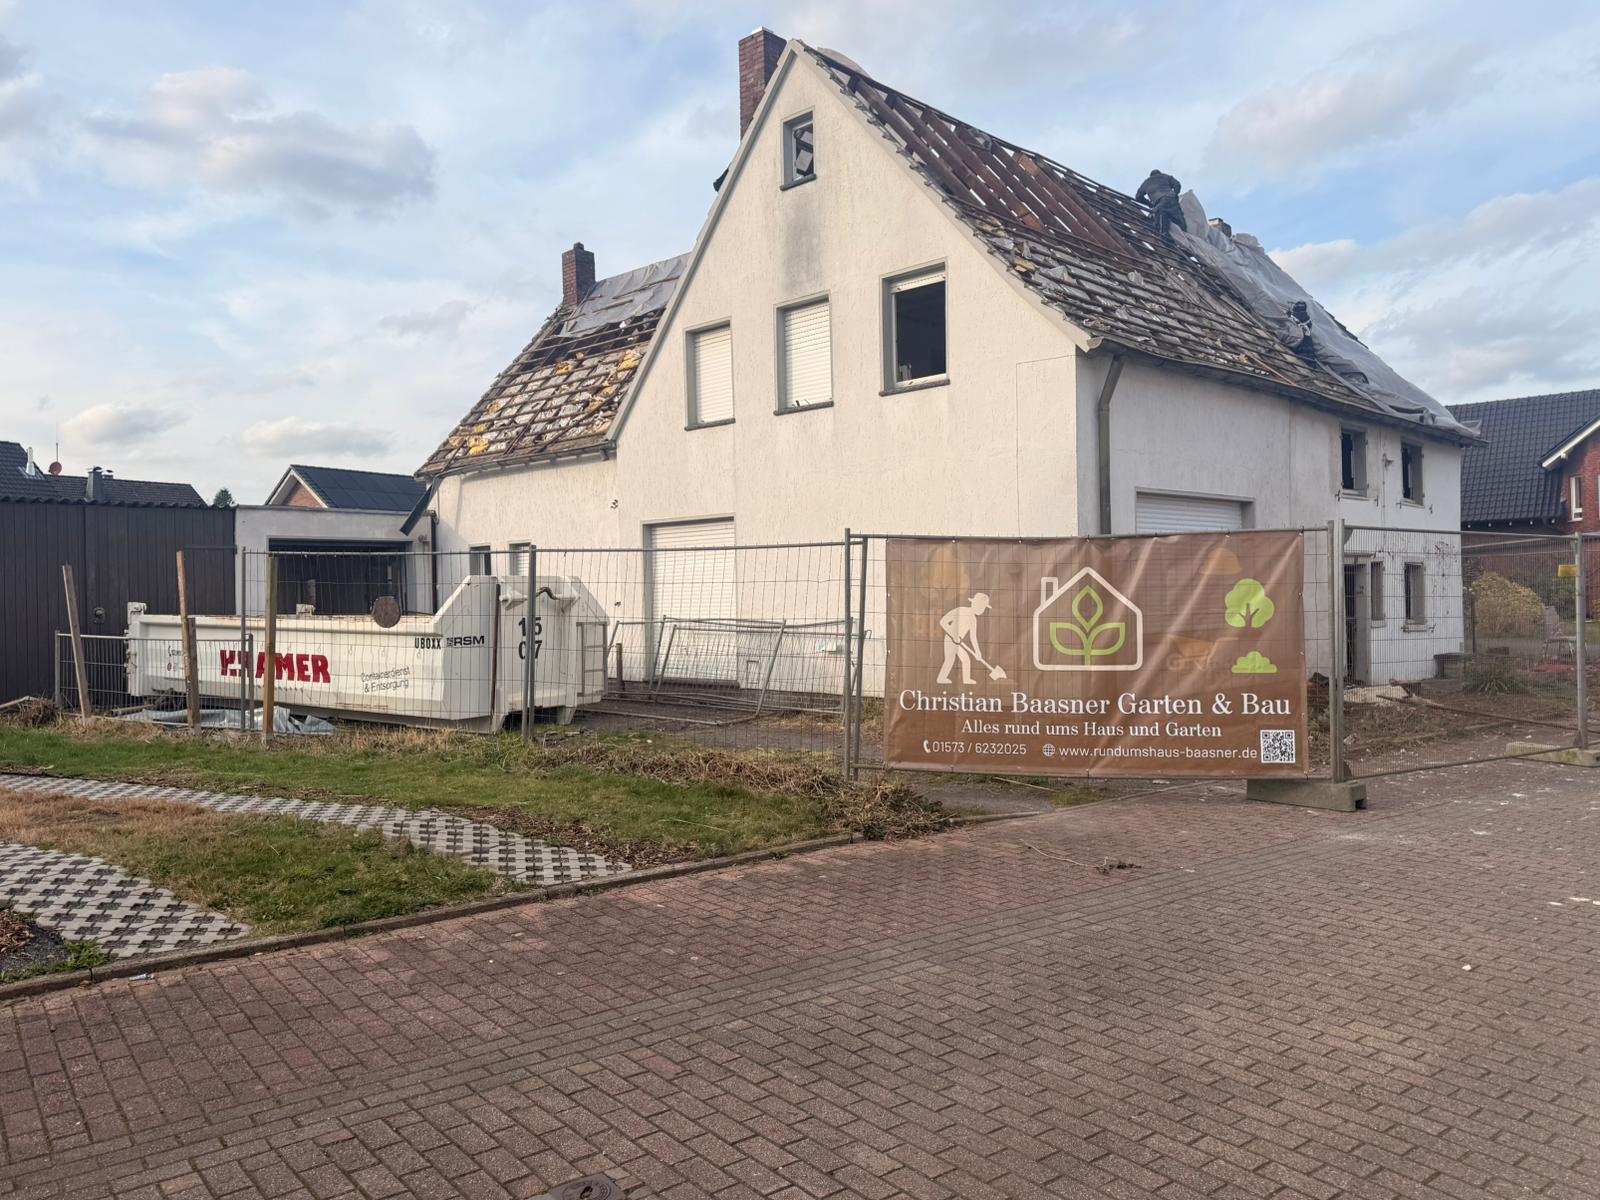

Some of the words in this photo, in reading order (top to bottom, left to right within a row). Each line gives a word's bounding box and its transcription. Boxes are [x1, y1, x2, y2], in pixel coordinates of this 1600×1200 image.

[414, 637, 441, 650] UBOXX
[364, 683, 370, 693] &
[370, 679, 409, 692] Entsorgung
[899, 689, 1003, 712] Christian
[1010, 691, 1110, 714] Baasner
[1117, 692, 1203, 715] Garten
[1211, 692, 1233, 715] &
[1240, 692, 1291, 715] Bau
[961, 720, 1000, 734] Alles
[1004, 721, 1040, 735] rund
[1045, 725, 1079, 736] ums
[1083, 722, 1124, 736] Haus
[1129, 722, 1160, 737] und
[1165, 722, 1222, 737] Garten
[932, 741, 965, 753] 01573
[967, 742, 972, 753] /
[975, 743, 1027, 755] 6232025
[1058, 746, 1258, 759] www.rundumshaus-baasner.de
